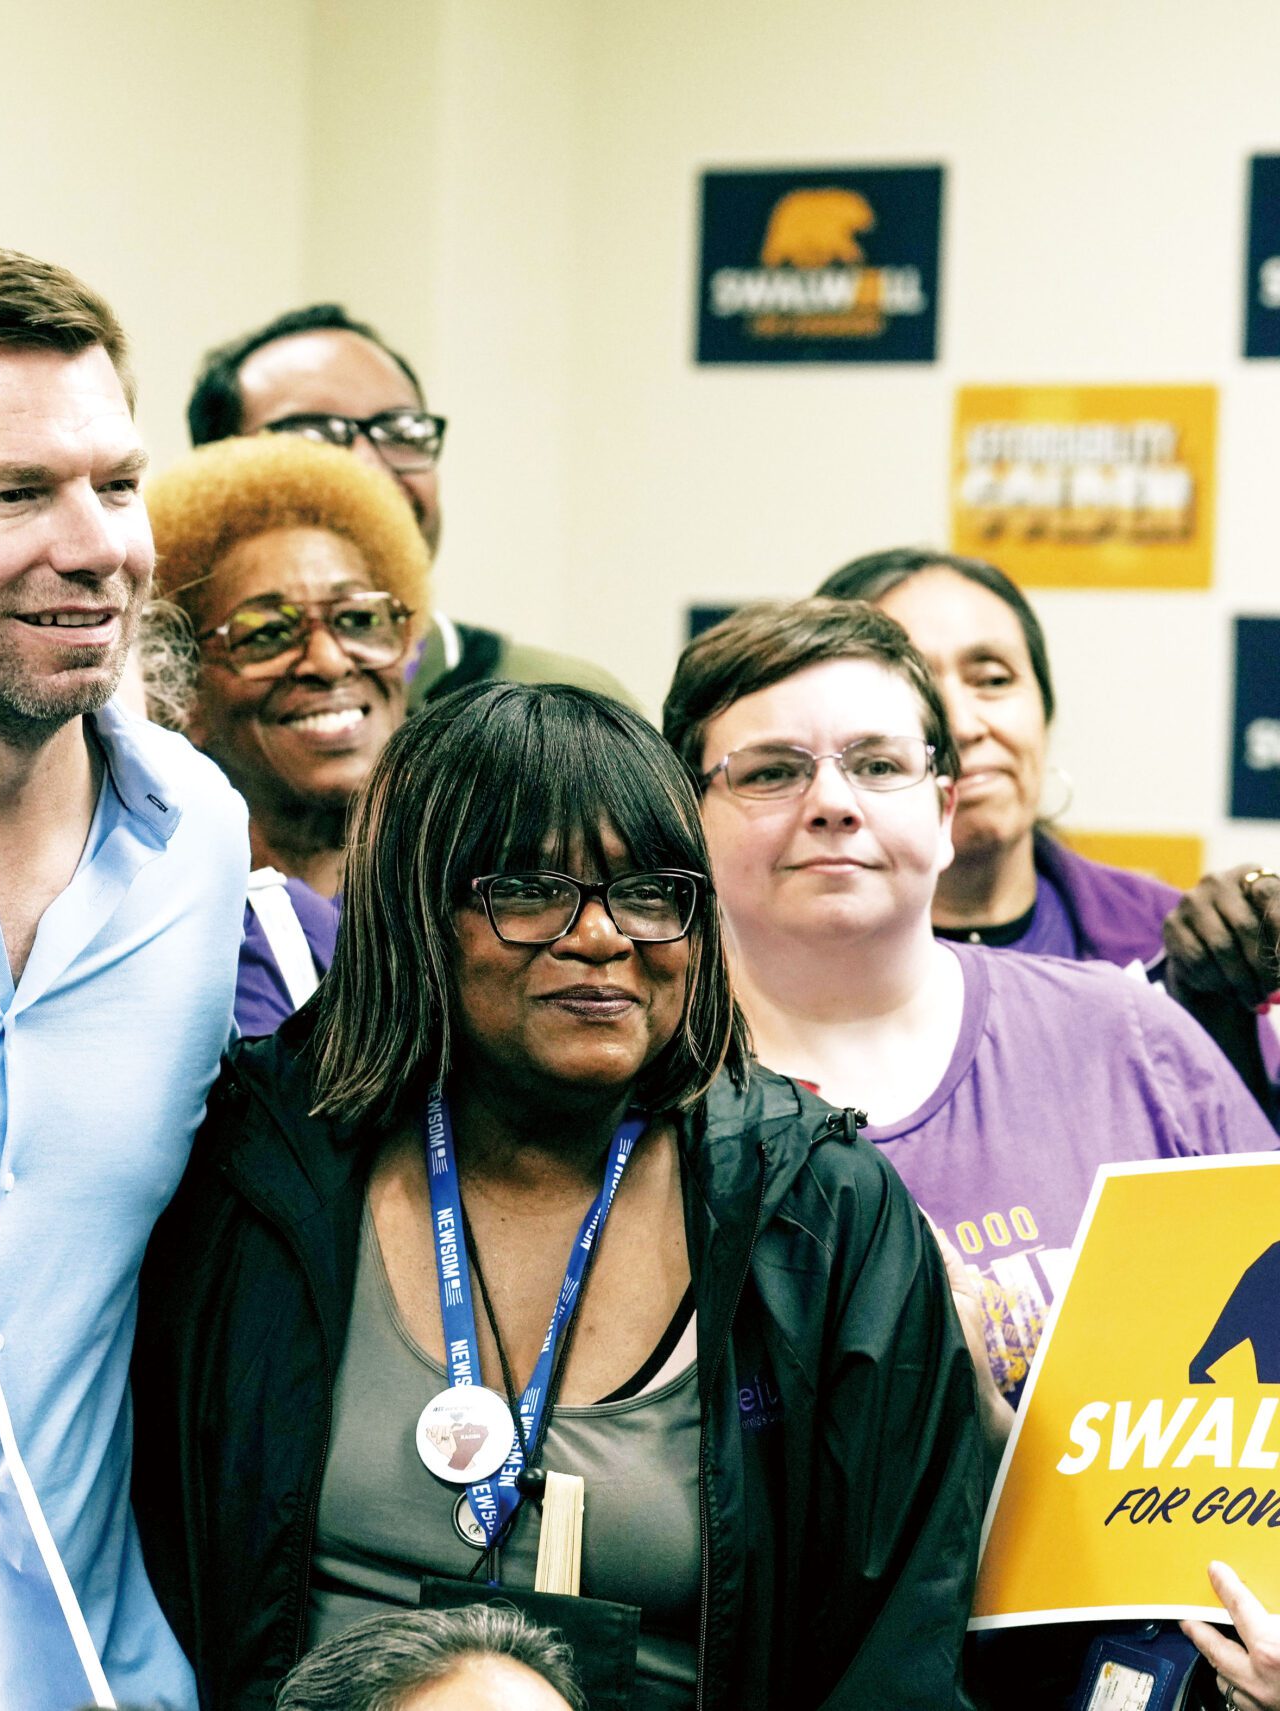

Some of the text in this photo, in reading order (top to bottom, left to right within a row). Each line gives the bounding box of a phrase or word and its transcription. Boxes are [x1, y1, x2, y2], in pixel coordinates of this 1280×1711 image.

[436, 1207, 462, 1280] NEWSOM
[937, 1205, 1040, 1255] 000
[1054, 1396, 1280, 1476] SWAL
[1103, 1485, 1192, 1527] FOR
